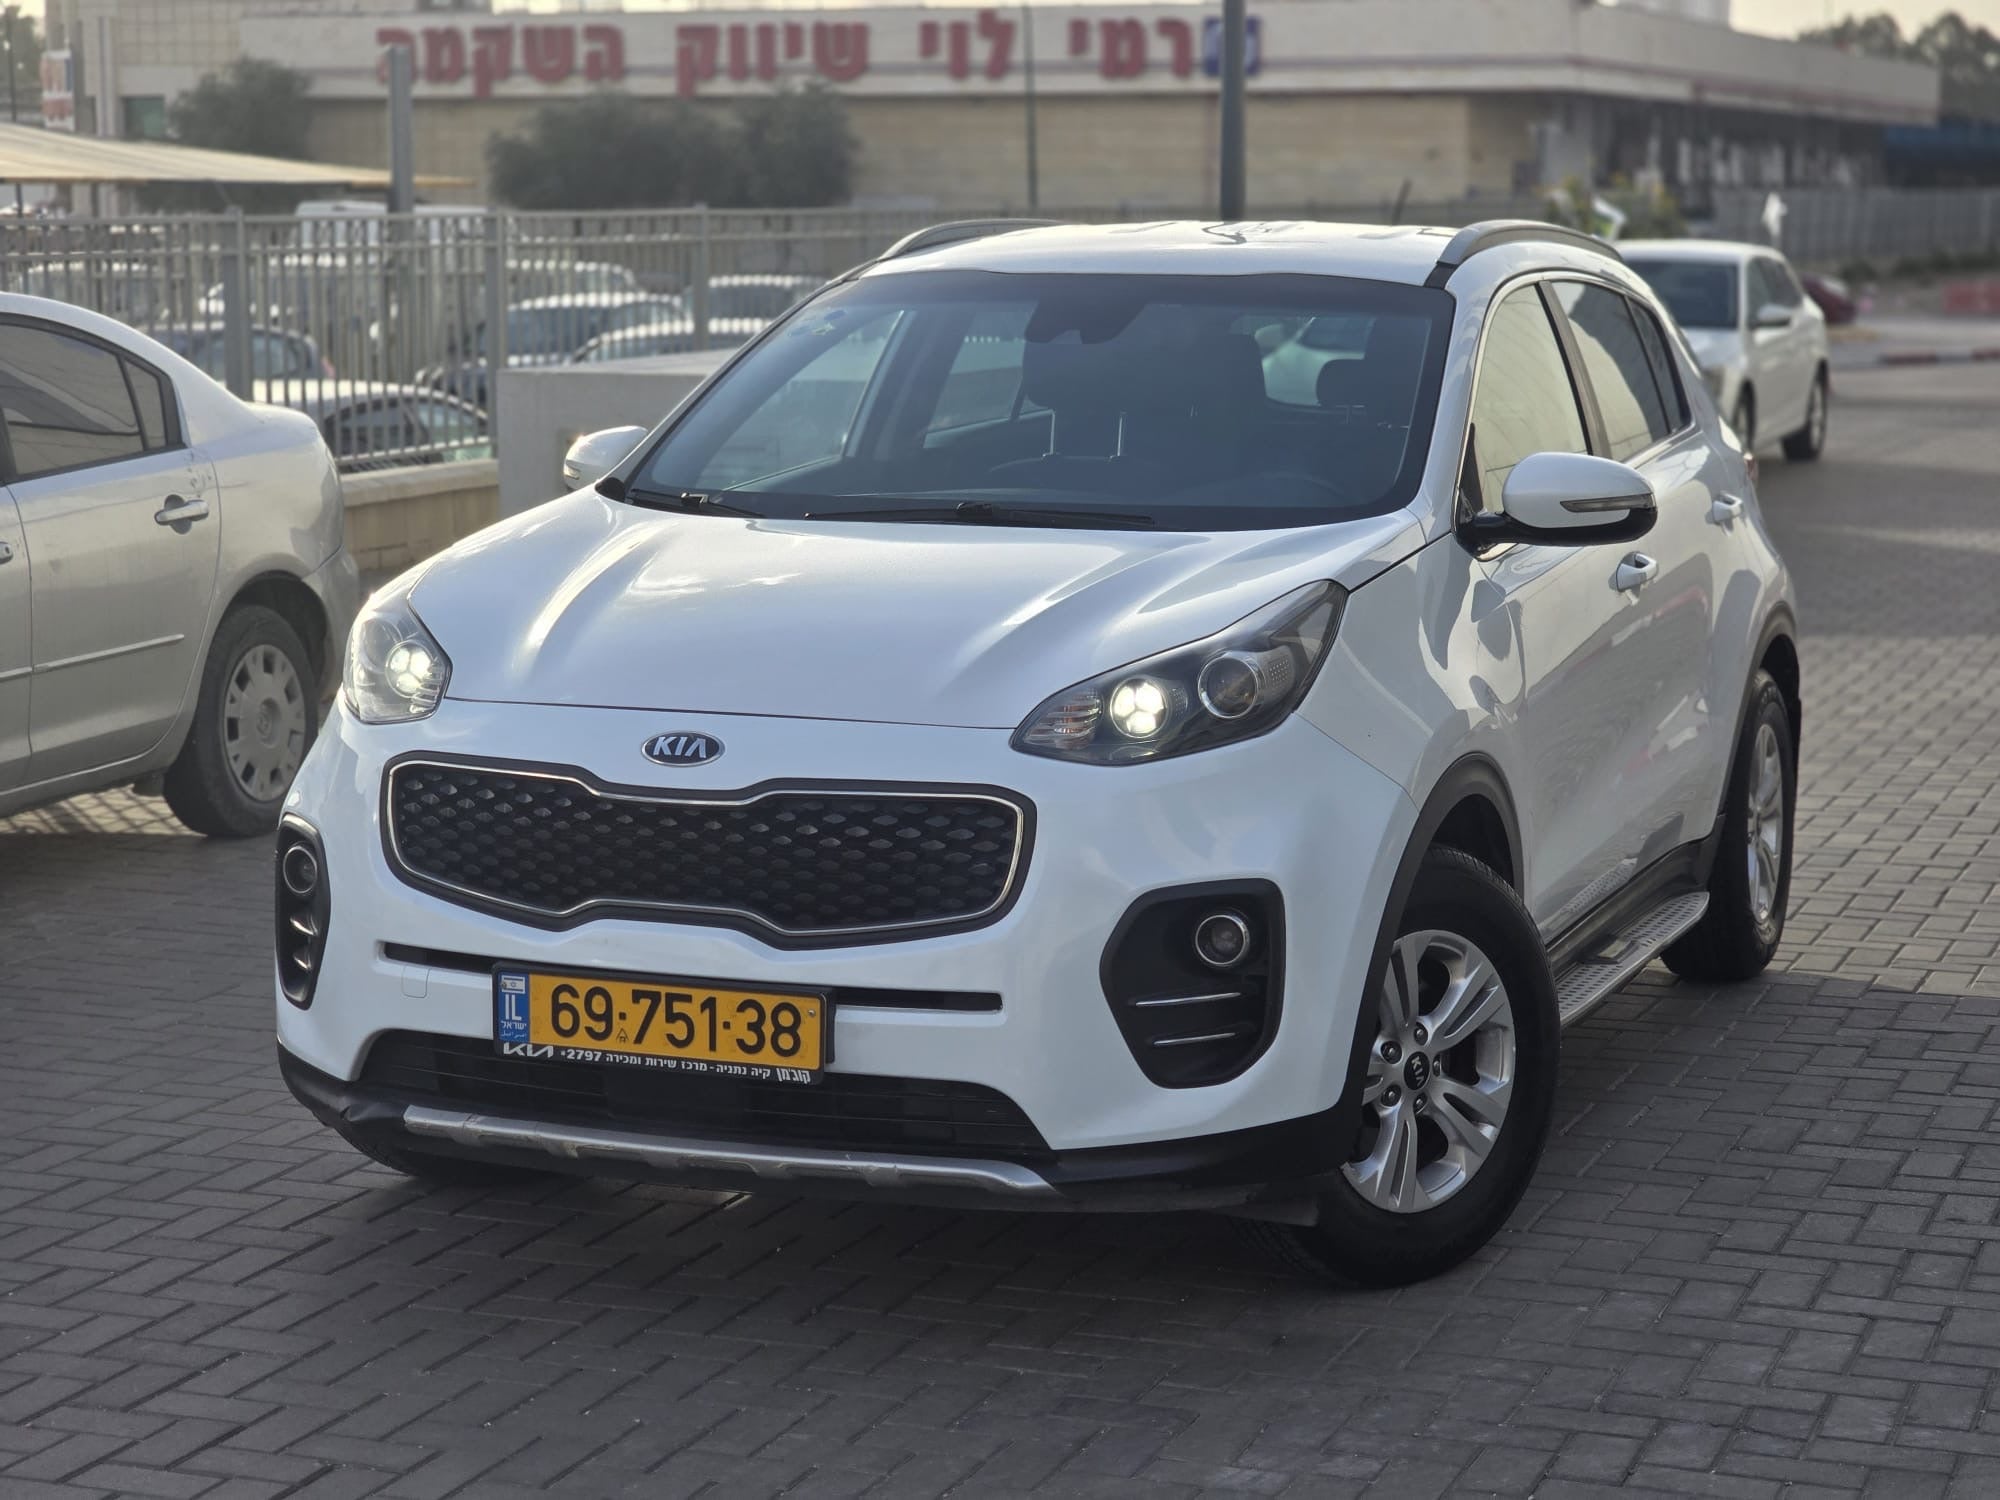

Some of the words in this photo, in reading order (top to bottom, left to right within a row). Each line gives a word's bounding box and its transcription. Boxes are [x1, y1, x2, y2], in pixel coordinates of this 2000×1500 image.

[918, 9, 1017, 81] לוי
[1068, 18, 1195, 80] רמי
[676, 21, 870, 97] שיווק
[653, 736, 706, 758] KIA
[505, 993, 522, 1021] IL
[501, 1020, 527, 1030] ישראל
[605, 1053, 642, 1065] ומכירה
[645, 1057, 677, 1069] שירות
[681, 1060, 708, 1072] מרכז
[716, 1064, 748, 1075] נתניה
[751, 1067, 771, 1080] קיה
[1411, 1055, 1425, 1088] KIA
